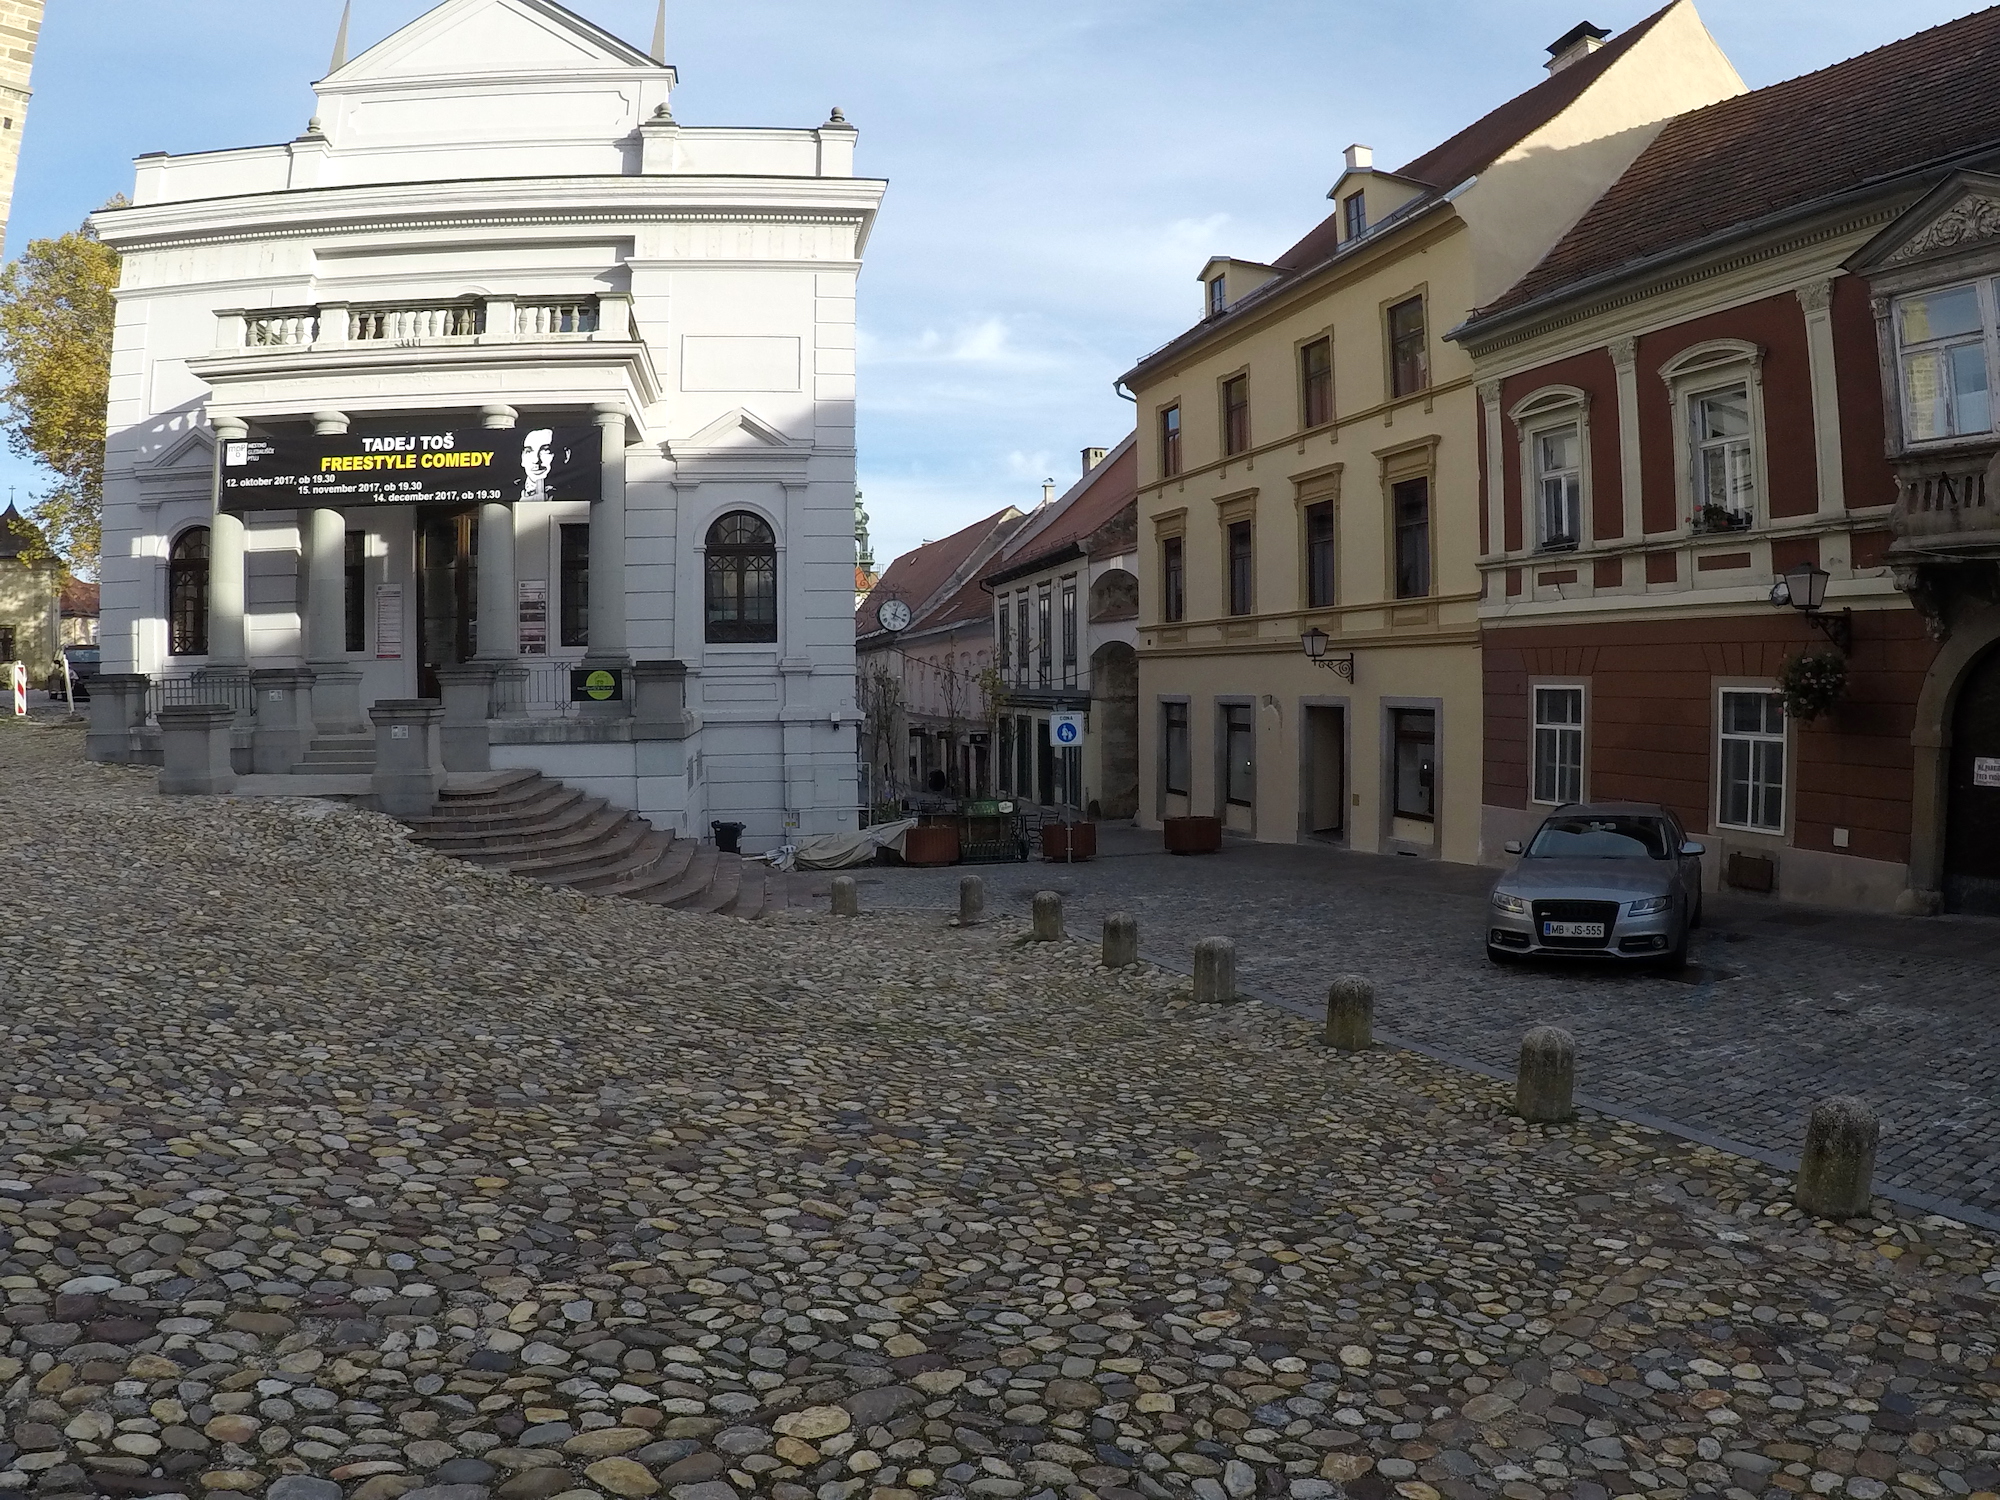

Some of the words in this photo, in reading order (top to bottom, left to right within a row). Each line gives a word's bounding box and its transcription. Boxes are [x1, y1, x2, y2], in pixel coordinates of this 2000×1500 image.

[362, 436, 416, 452] TADEJ
[420, 432, 455, 450] TOŠ
[321, 454, 417, 472] FREESTYLE
[421, 452, 495, 469] COMEDY
[226, 479, 239, 487] 12.
[240, 477, 273, 487] oktober
[273, 475, 297, 485] 2017,
[298, 475, 311, 484] ob
[312, 473, 336, 483] 19.30
[298, 486, 311, 495] 15.
[313, 484, 357, 494] november
[358, 483, 382, 493] 2017,
[384, 482, 396, 491] ob
[398, 481, 423, 491] 19.30
[373, 493, 386, 502] 14.
[388, 491, 434, 501] december
[435, 491, 459, 501] 2017,
[461, 490, 474, 499] ob
[476, 489, 501, 499] 19.30
[1551, 924, 1564, 934] MB
[1571, 925, 1602, 936] JS-555
